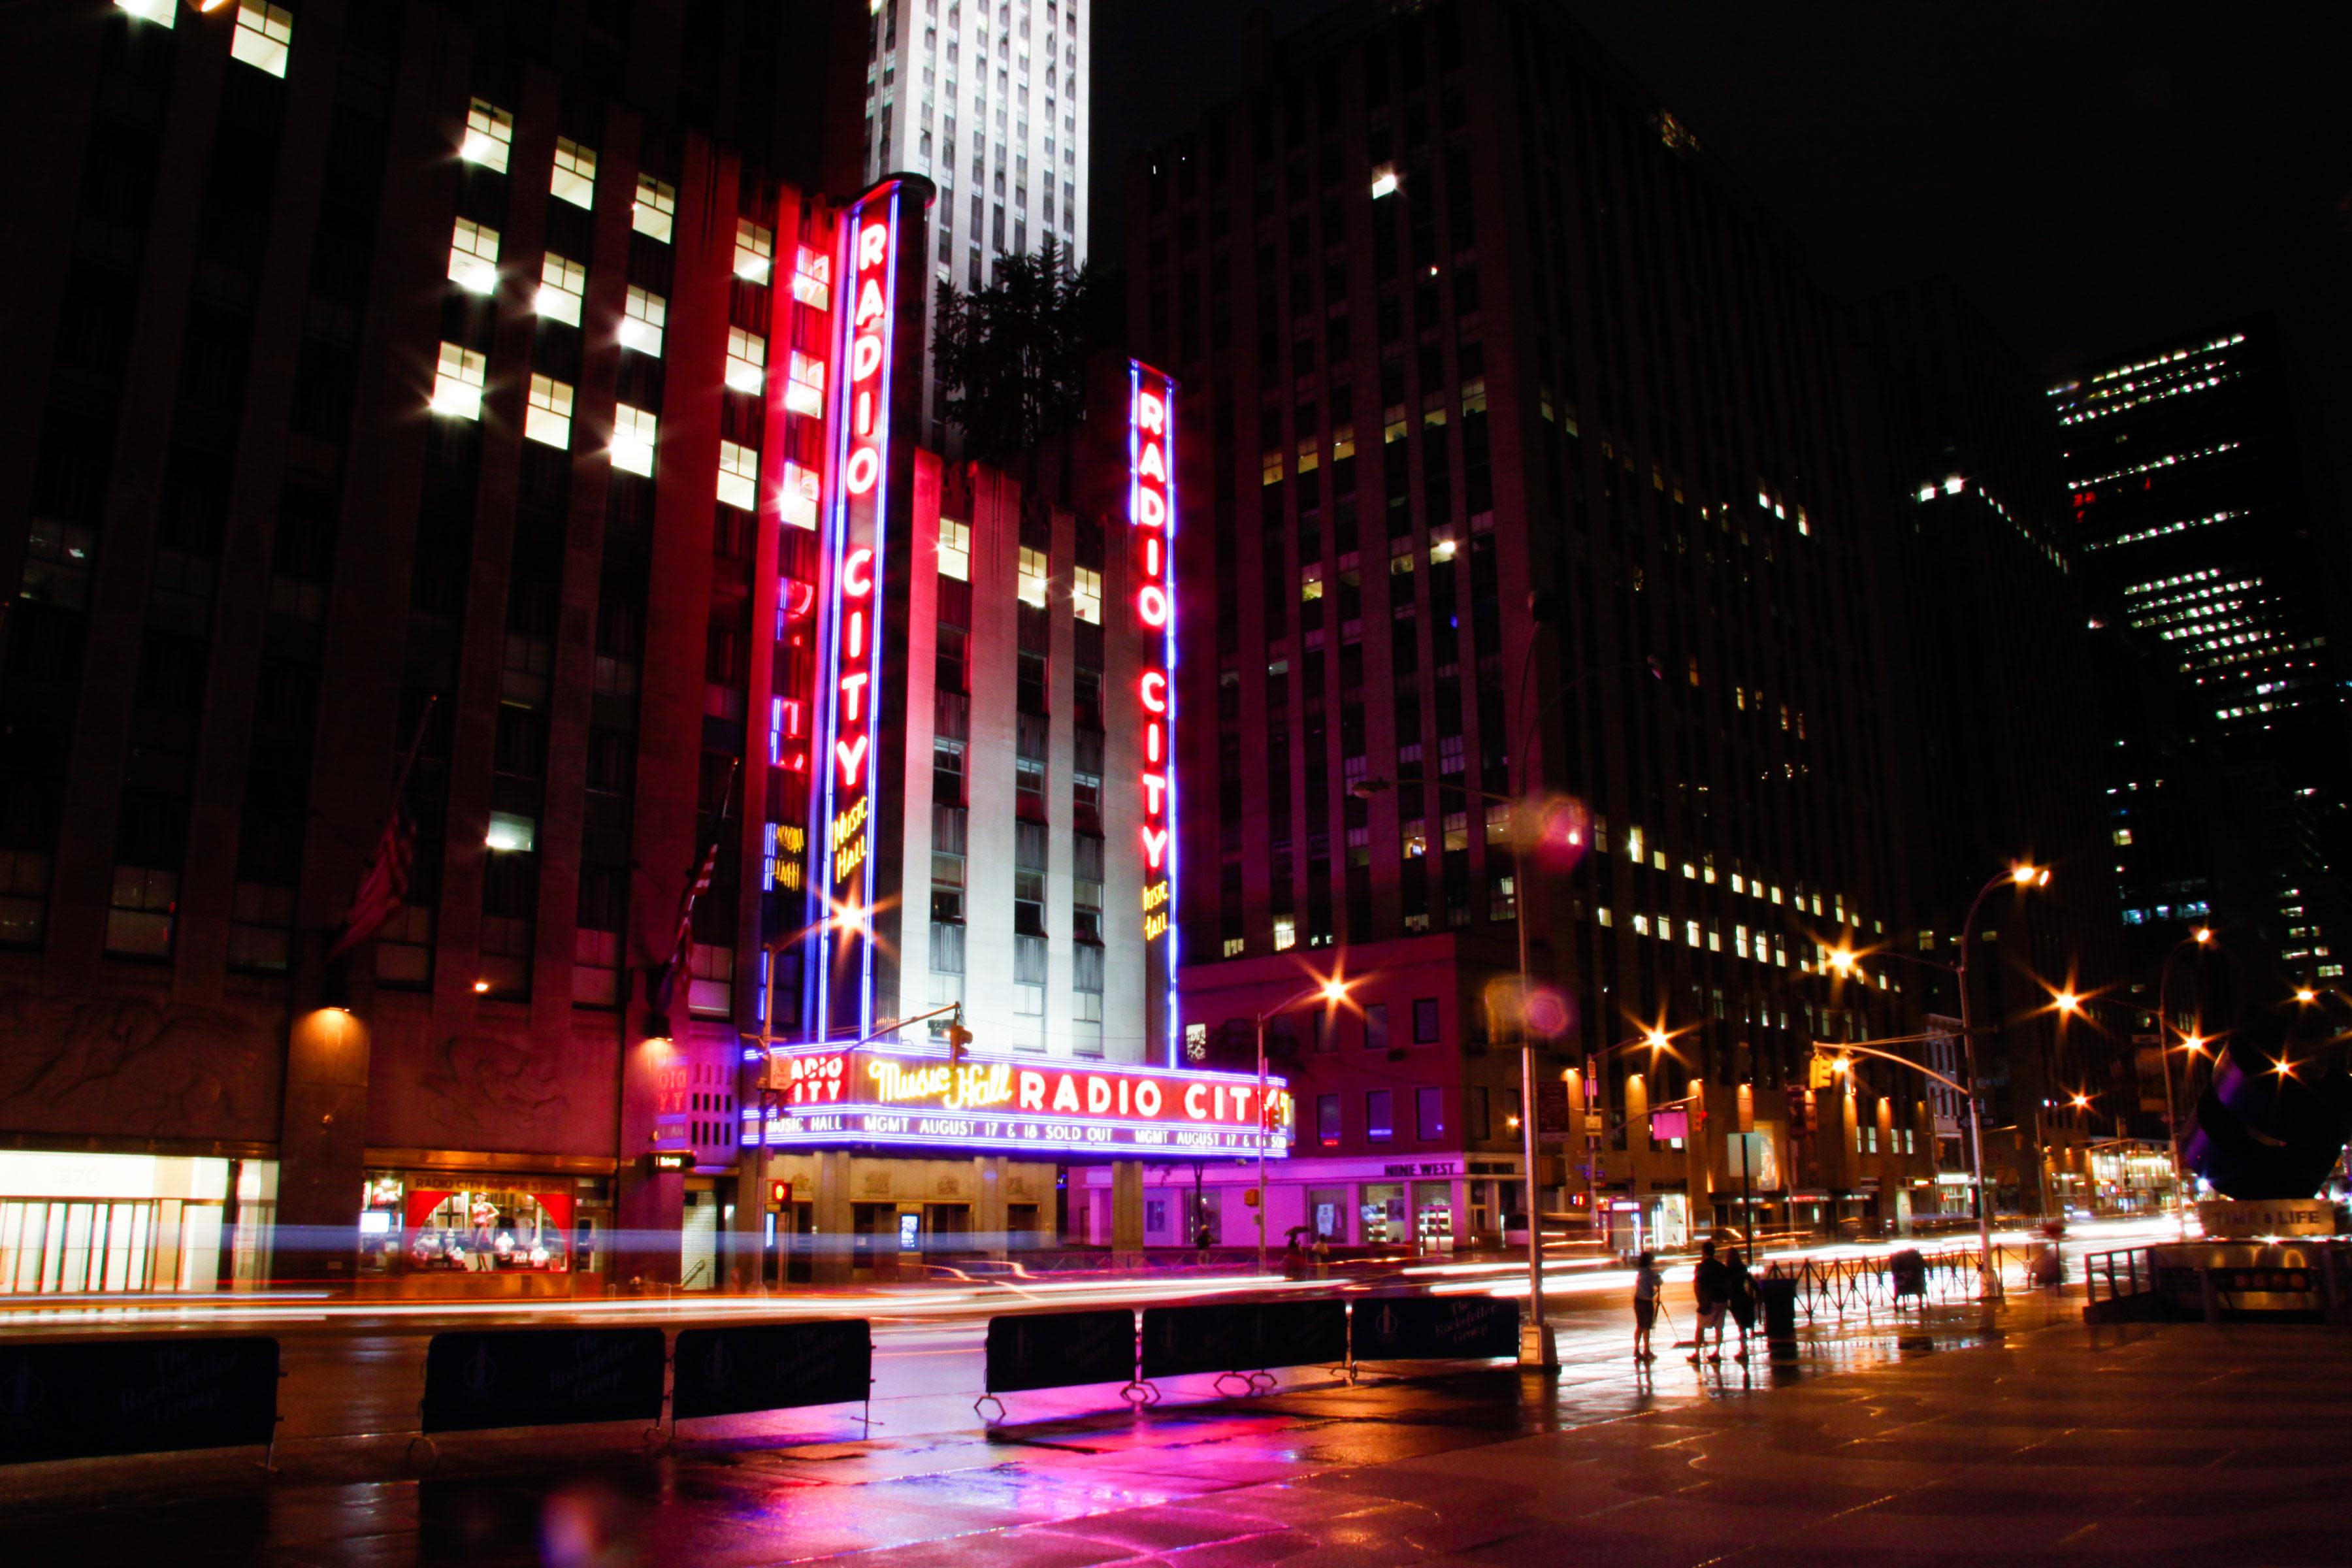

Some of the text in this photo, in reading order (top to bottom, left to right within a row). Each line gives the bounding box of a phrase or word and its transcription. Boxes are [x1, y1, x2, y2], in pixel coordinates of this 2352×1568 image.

[836, 223, 886, 785] RADIO CITY
[1139, 392, 1168, 868] RADIO CITY
[833, 797, 868, 851] MUSIC
[837, 836, 867, 883] HALL
[791, 1057, 843, 1079] ADIO
[794, 1080, 841, 1103] ITY
[868, 1059, 1013, 1109] Music Hall
[1019, 1070, 1162, 1117] RADIO
[766, 1115, 842, 1132] MUSIC HALL
[864, 1116, 1113, 1142] MGMT AUGUST 17 & 18 SOLD OUT
[1135, 1130, 1169, 1144] MGMT
[1176, 1132, 1220, 1147] AUGUST
[1226, 1134, 1237, 1147] 17
[1384, 1164, 1416, 1176] NINE
[1420, 1162, 1454, 1175] WEST
[415, 1178, 453, 1189] RADIO
[2278, 1211, 2320, 1224] LIFE
